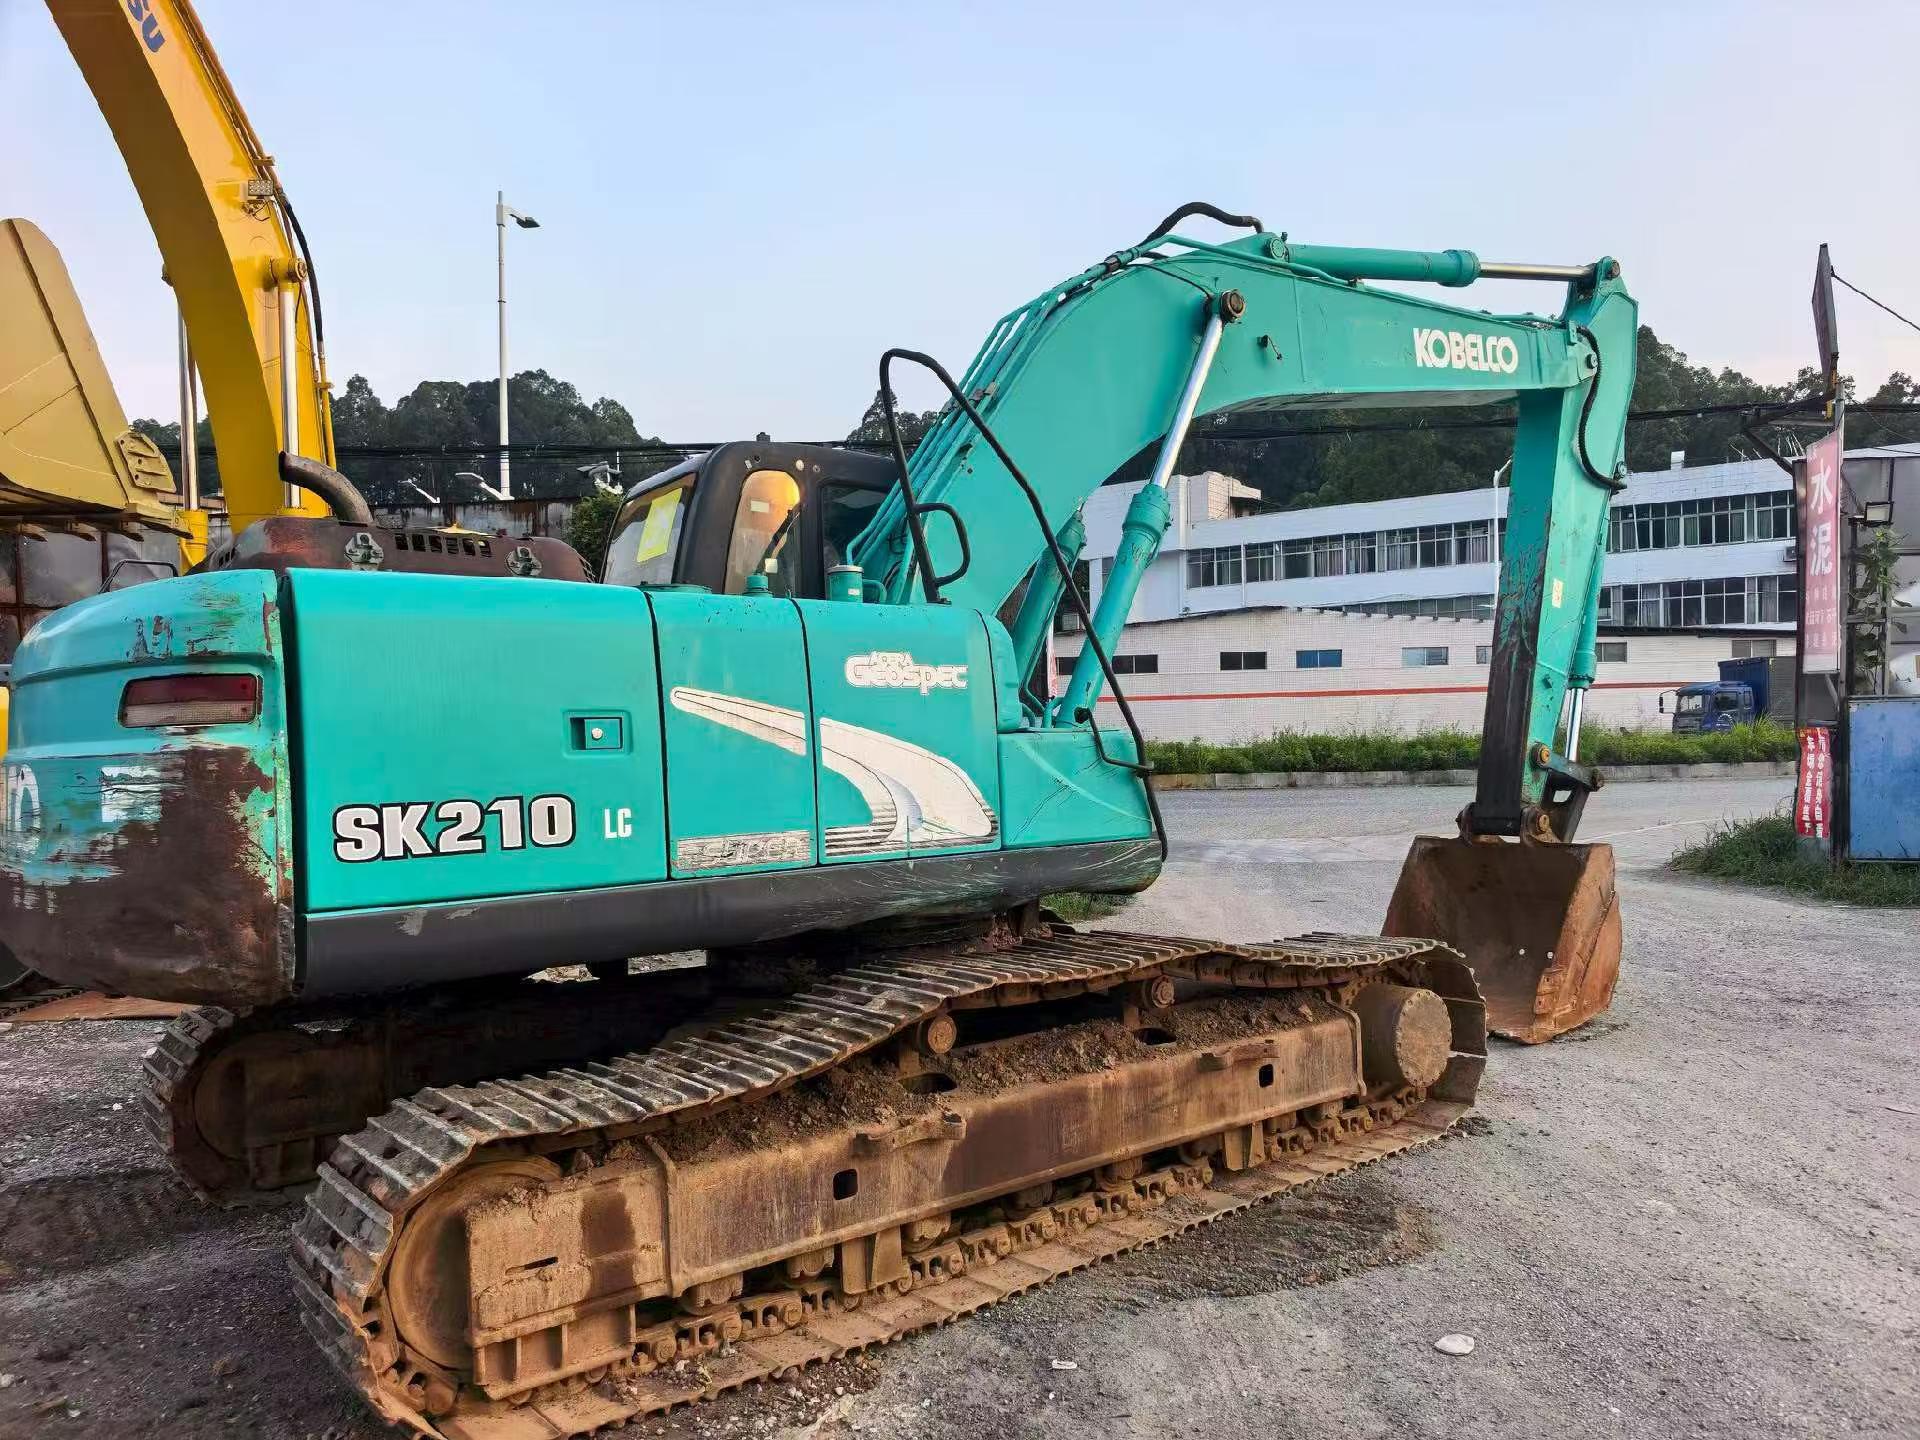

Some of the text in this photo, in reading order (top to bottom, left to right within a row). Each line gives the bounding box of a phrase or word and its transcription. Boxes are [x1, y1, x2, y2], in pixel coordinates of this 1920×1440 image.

[1412, 327, 1519, 374] KOBELCO
[1809, 458, 1834, 577] 水泥
[332, 793, 632, 864] SK210 LC
